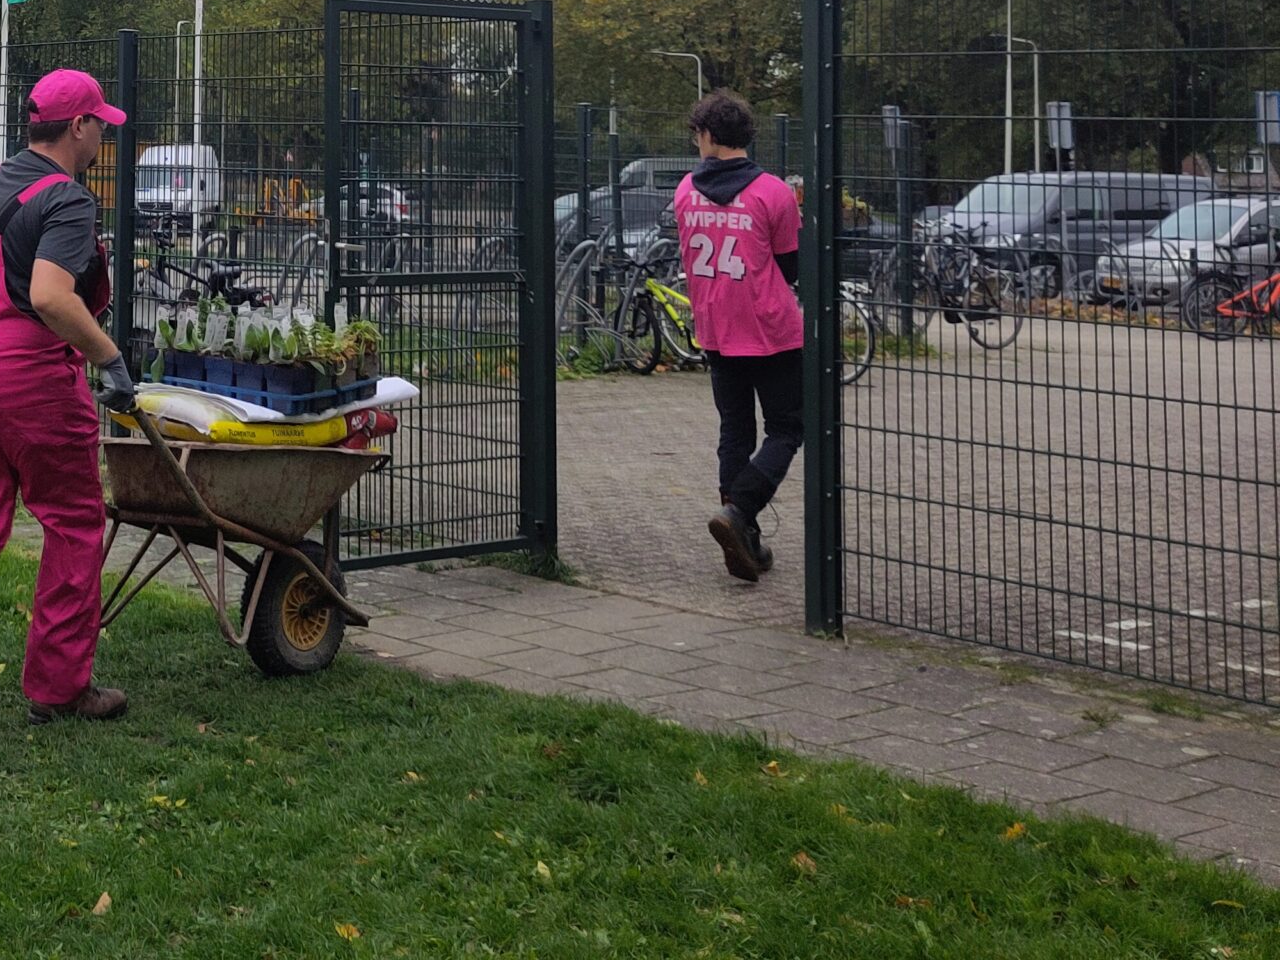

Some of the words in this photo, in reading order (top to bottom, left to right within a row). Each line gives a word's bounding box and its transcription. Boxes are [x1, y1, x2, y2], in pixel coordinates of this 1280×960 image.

[689, 190, 745, 208] TEL
[683, 211, 753, 230] WIPPER
[689, 233, 745, 280] 24
